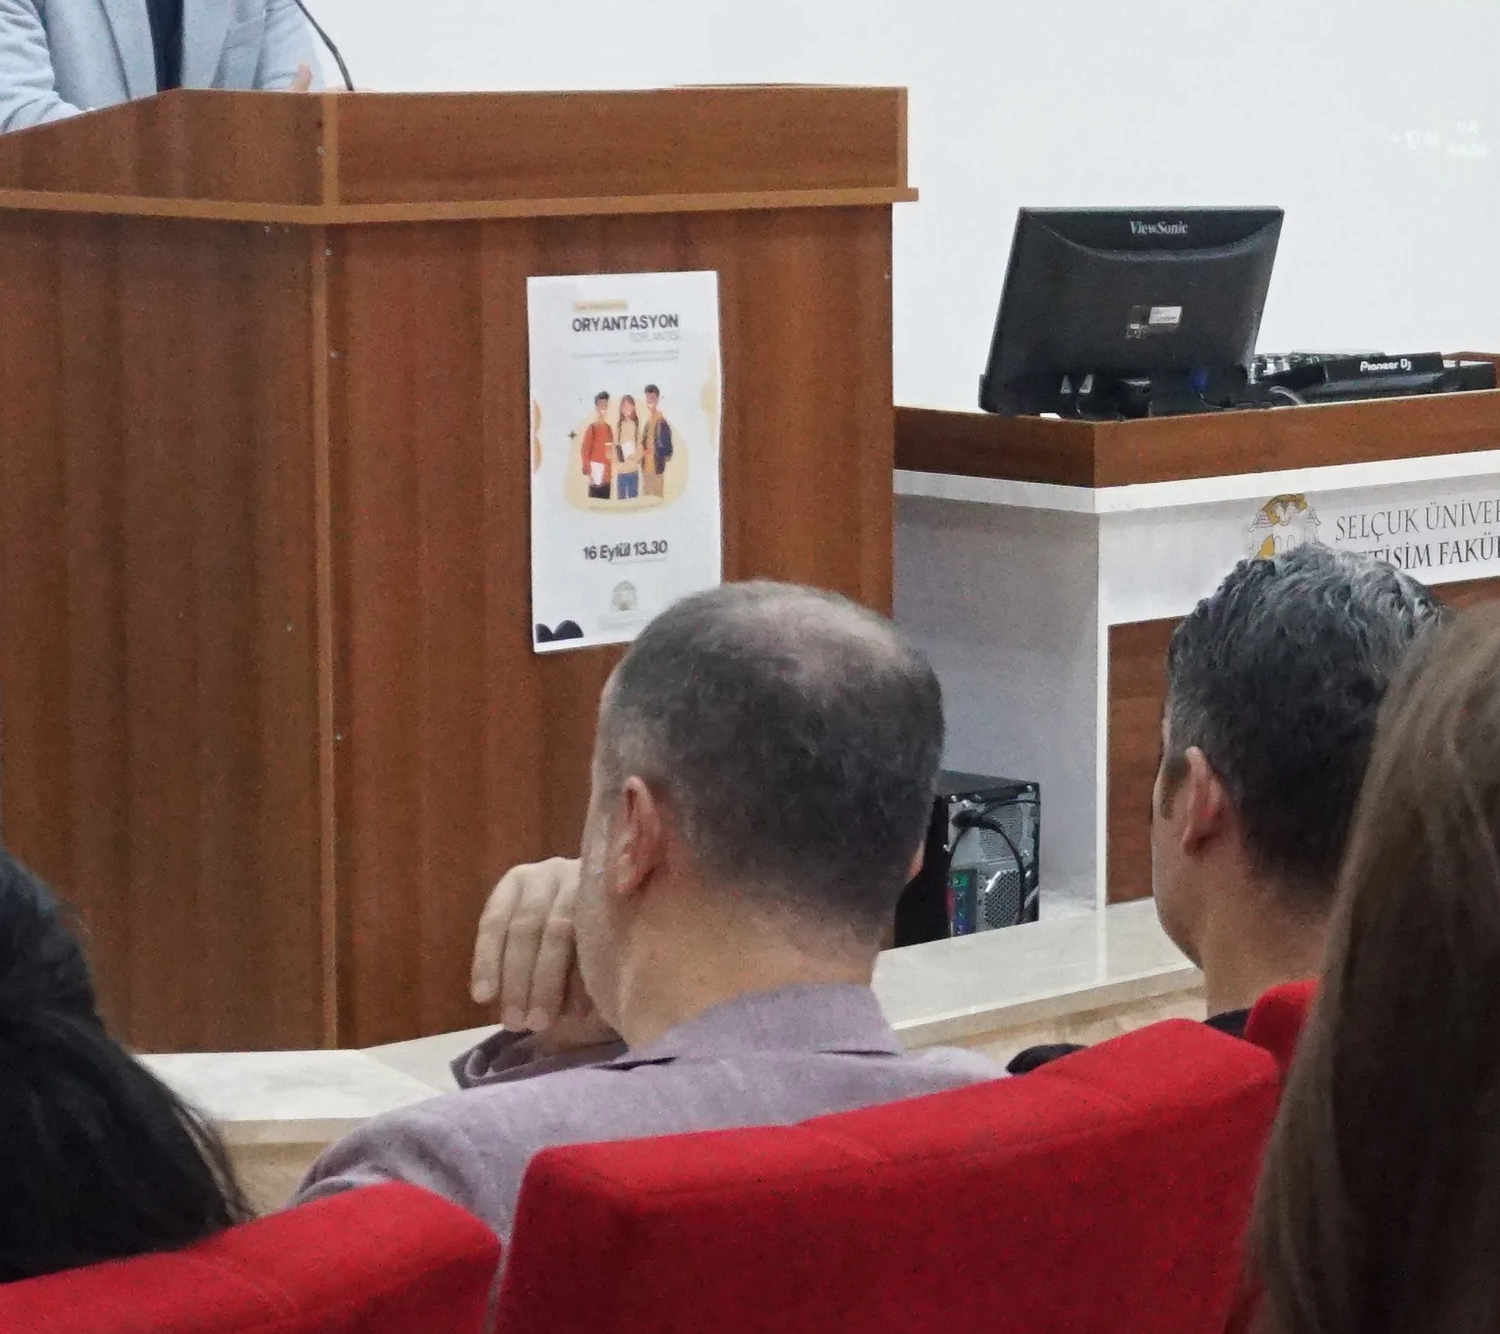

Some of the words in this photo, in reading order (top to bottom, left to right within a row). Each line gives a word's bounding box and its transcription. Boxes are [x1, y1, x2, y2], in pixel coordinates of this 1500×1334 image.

[1130, 220, 1188, 235] ViewSonic
[572, 313, 679, 332] ORYANTASYON
[1360, 361, 1398, 372] Pioneer
[1335, 508, 1419, 542] SELÇUK
[583, 546, 597, 560] 16
[600, 543, 630, 562] Eylül
[633, 540, 668, 556] 13.30
[1357, 541, 1432, 569] İŞİM
